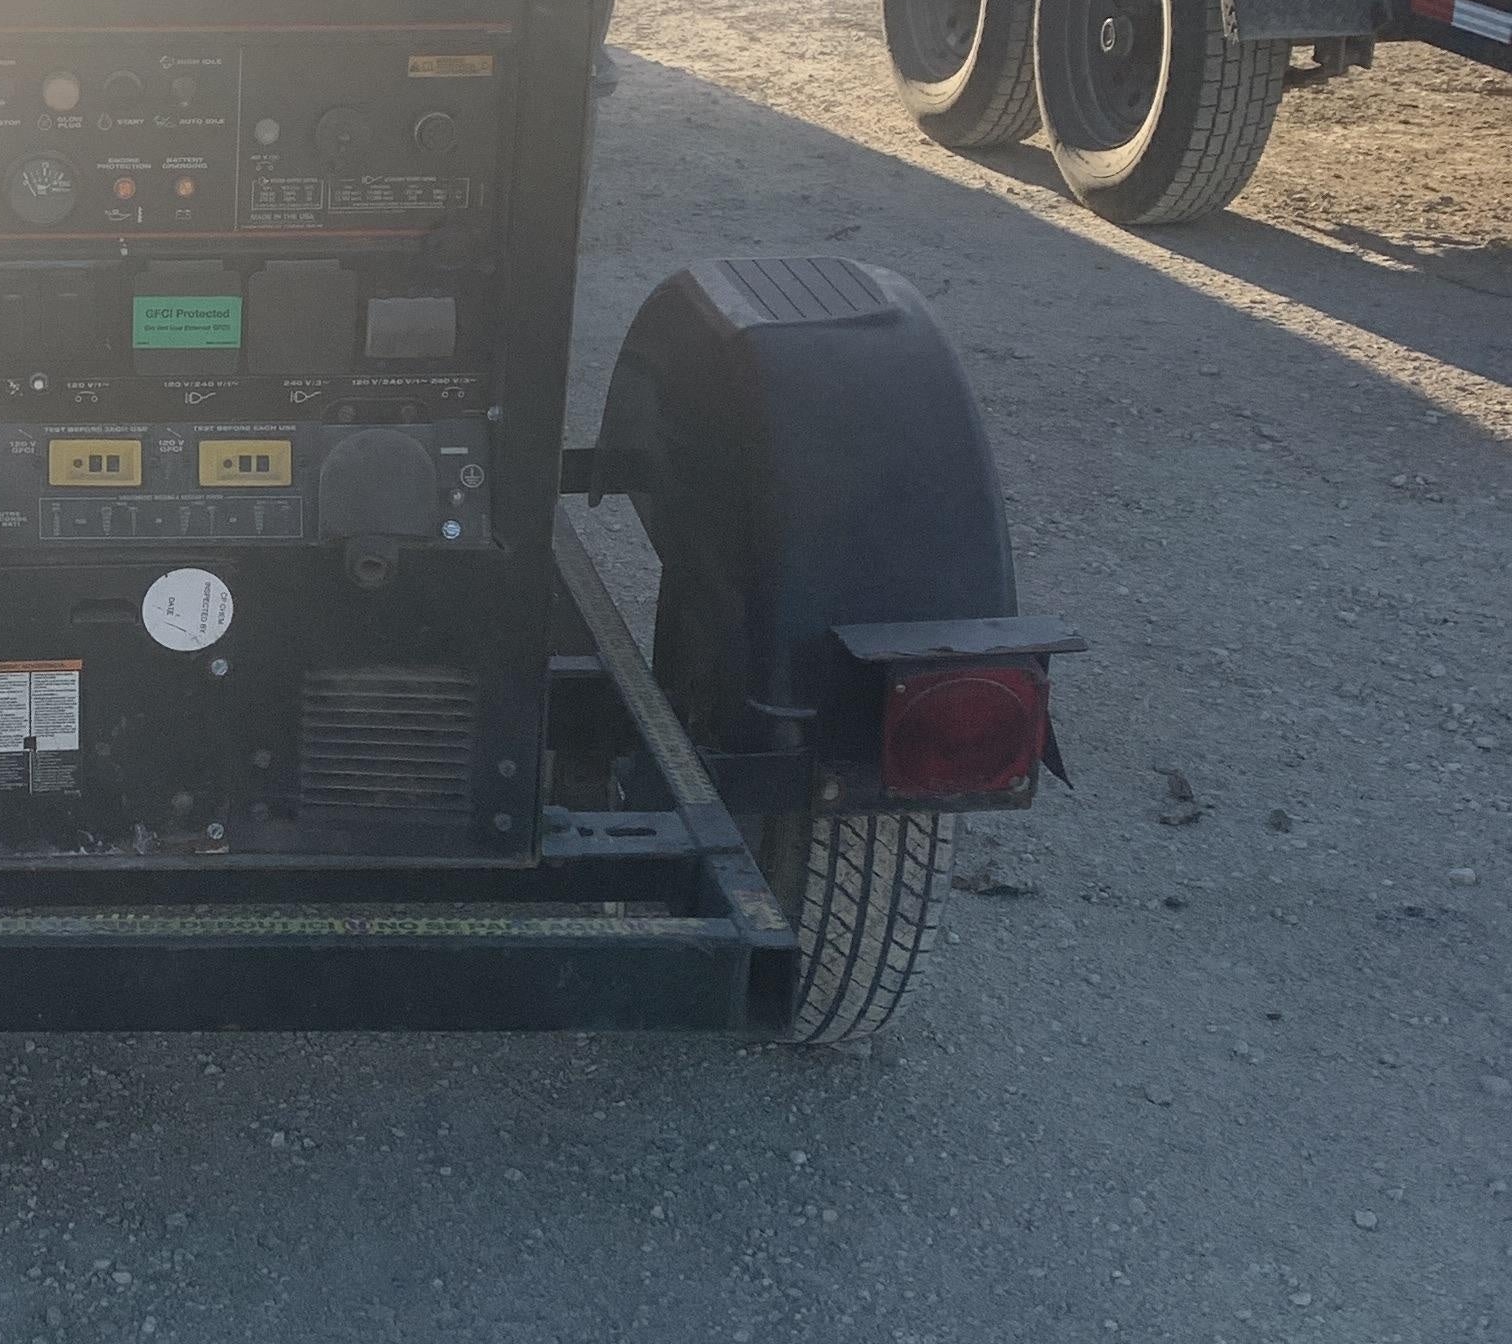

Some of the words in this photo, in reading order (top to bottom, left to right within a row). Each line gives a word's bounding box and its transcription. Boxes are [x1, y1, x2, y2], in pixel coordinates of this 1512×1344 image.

[145, 308, 173, 319] GFCI
[176, 308, 230, 319] Protected
[166, 596, 176, 617] DATE
[200, 581, 211, 623] INSPECTED
[199, 623, 207, 634] BY
